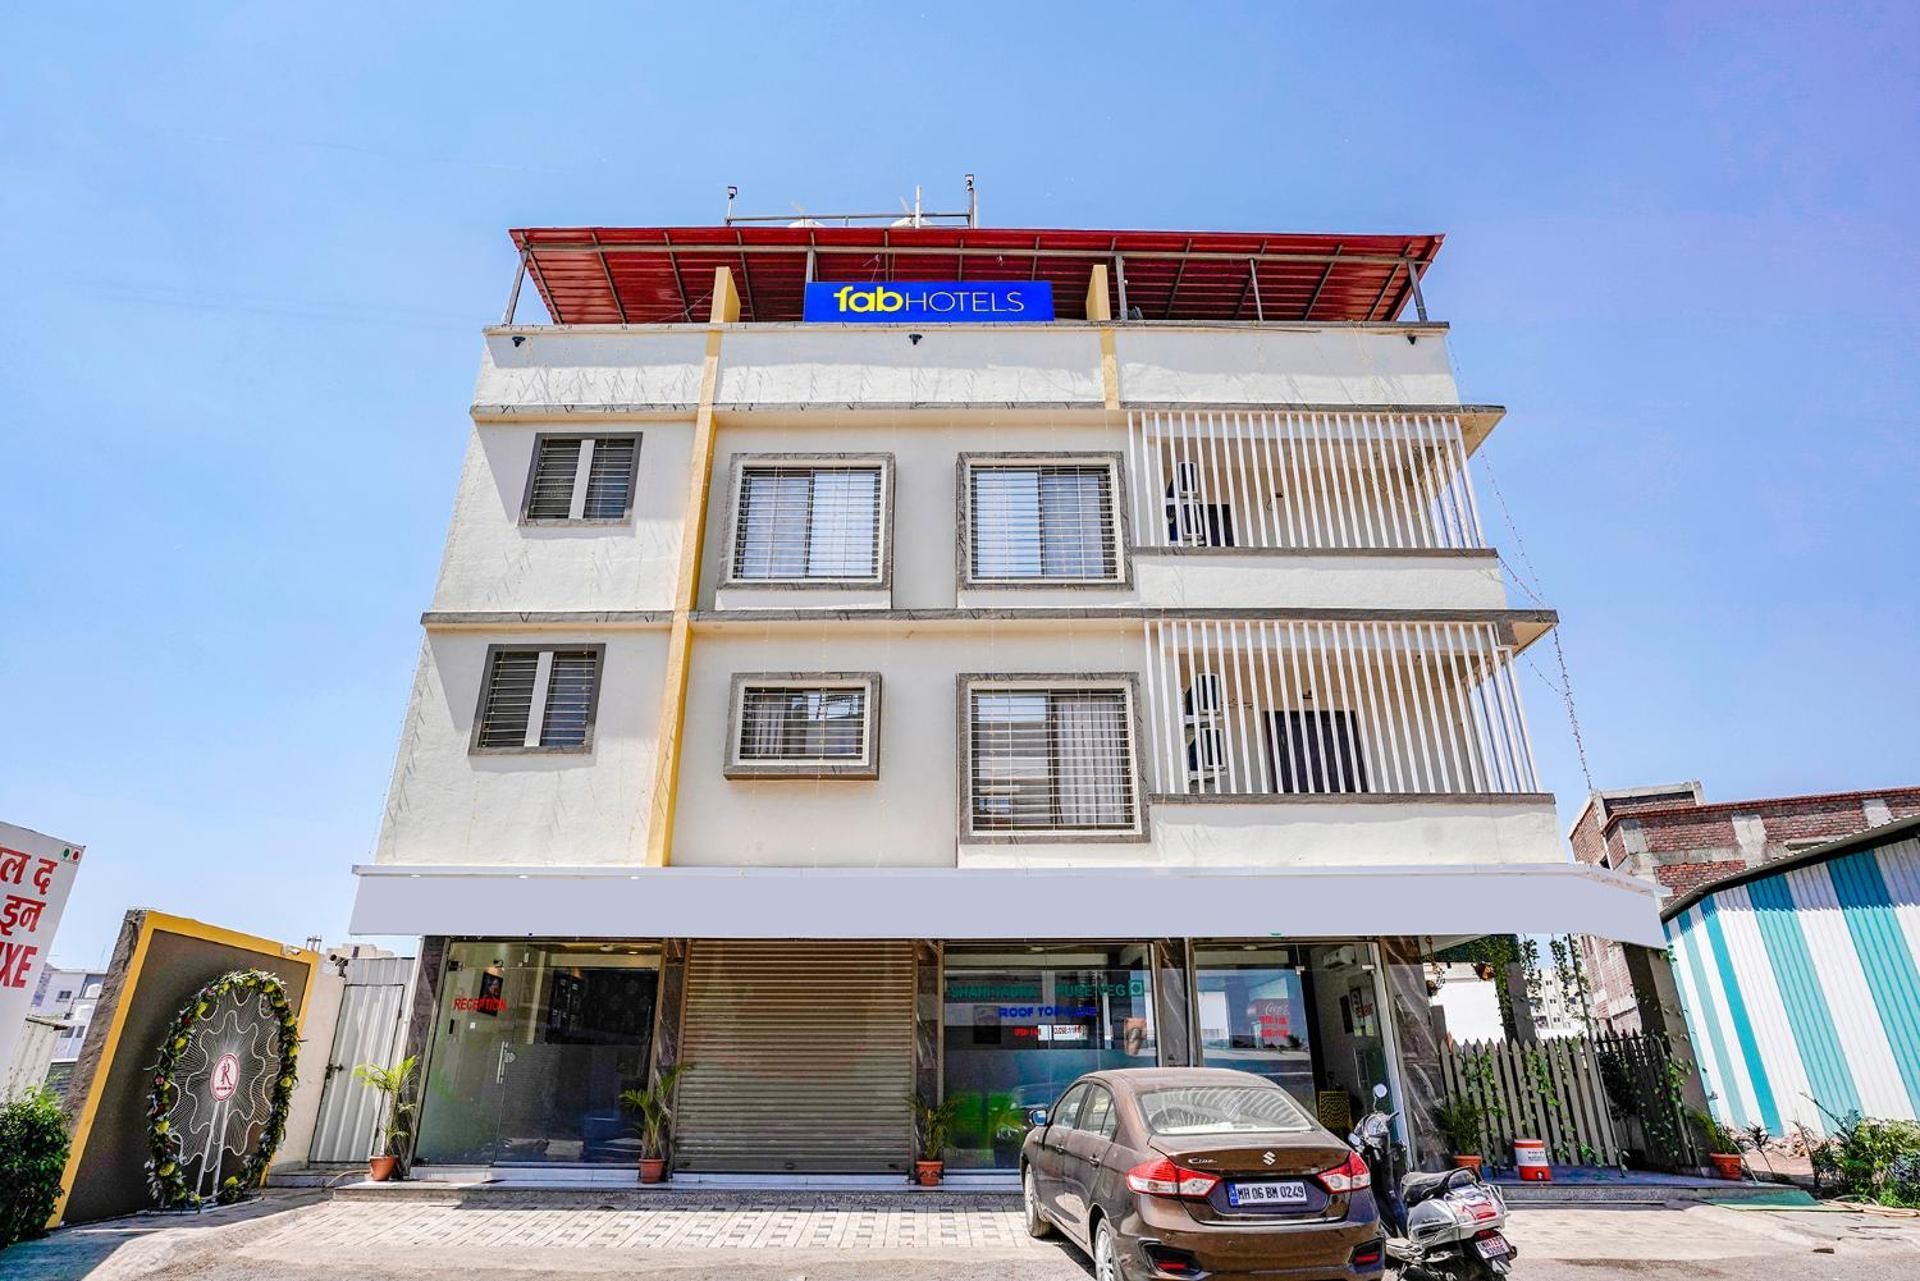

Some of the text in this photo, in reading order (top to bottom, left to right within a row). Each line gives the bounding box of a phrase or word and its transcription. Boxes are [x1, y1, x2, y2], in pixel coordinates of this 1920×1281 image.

[833, 285, 1025, 313] fabHOTELS
[0, 846, 58, 895] ल द
[1055, 984, 1094, 997] PURE
[1098, 983, 1127, 997] VEG
[454, 997, 507, 1012] RECEPTION
[998, 1006, 1034, 1018] ROOF
[1038, 1006, 1063, 1017] TOP
[1237, 1185, 1305, 1200] MH 06 BM 0249
